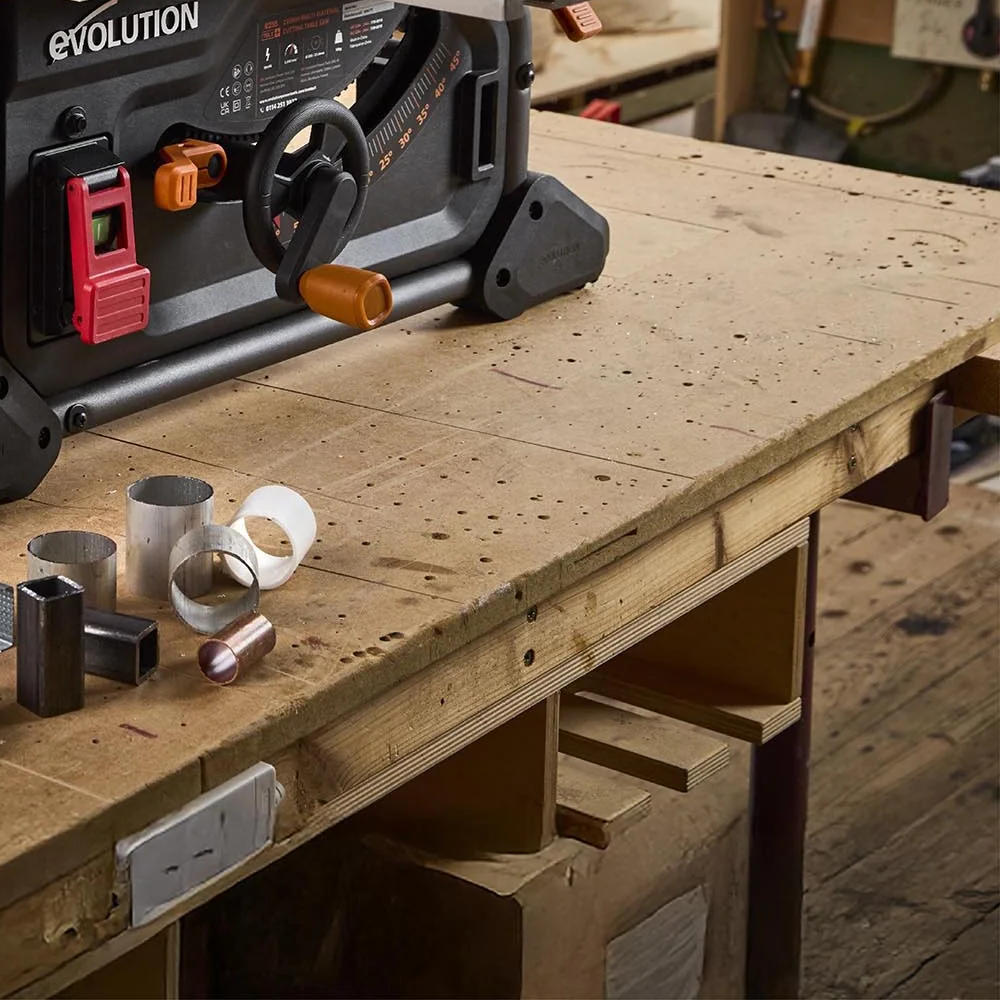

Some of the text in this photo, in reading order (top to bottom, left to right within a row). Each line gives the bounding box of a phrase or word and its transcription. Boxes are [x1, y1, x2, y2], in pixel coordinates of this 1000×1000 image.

[416, 103, 430, 125] 35°
[398, 127, 412, 149] 30°
[379, 150, 393, 171] 25°
